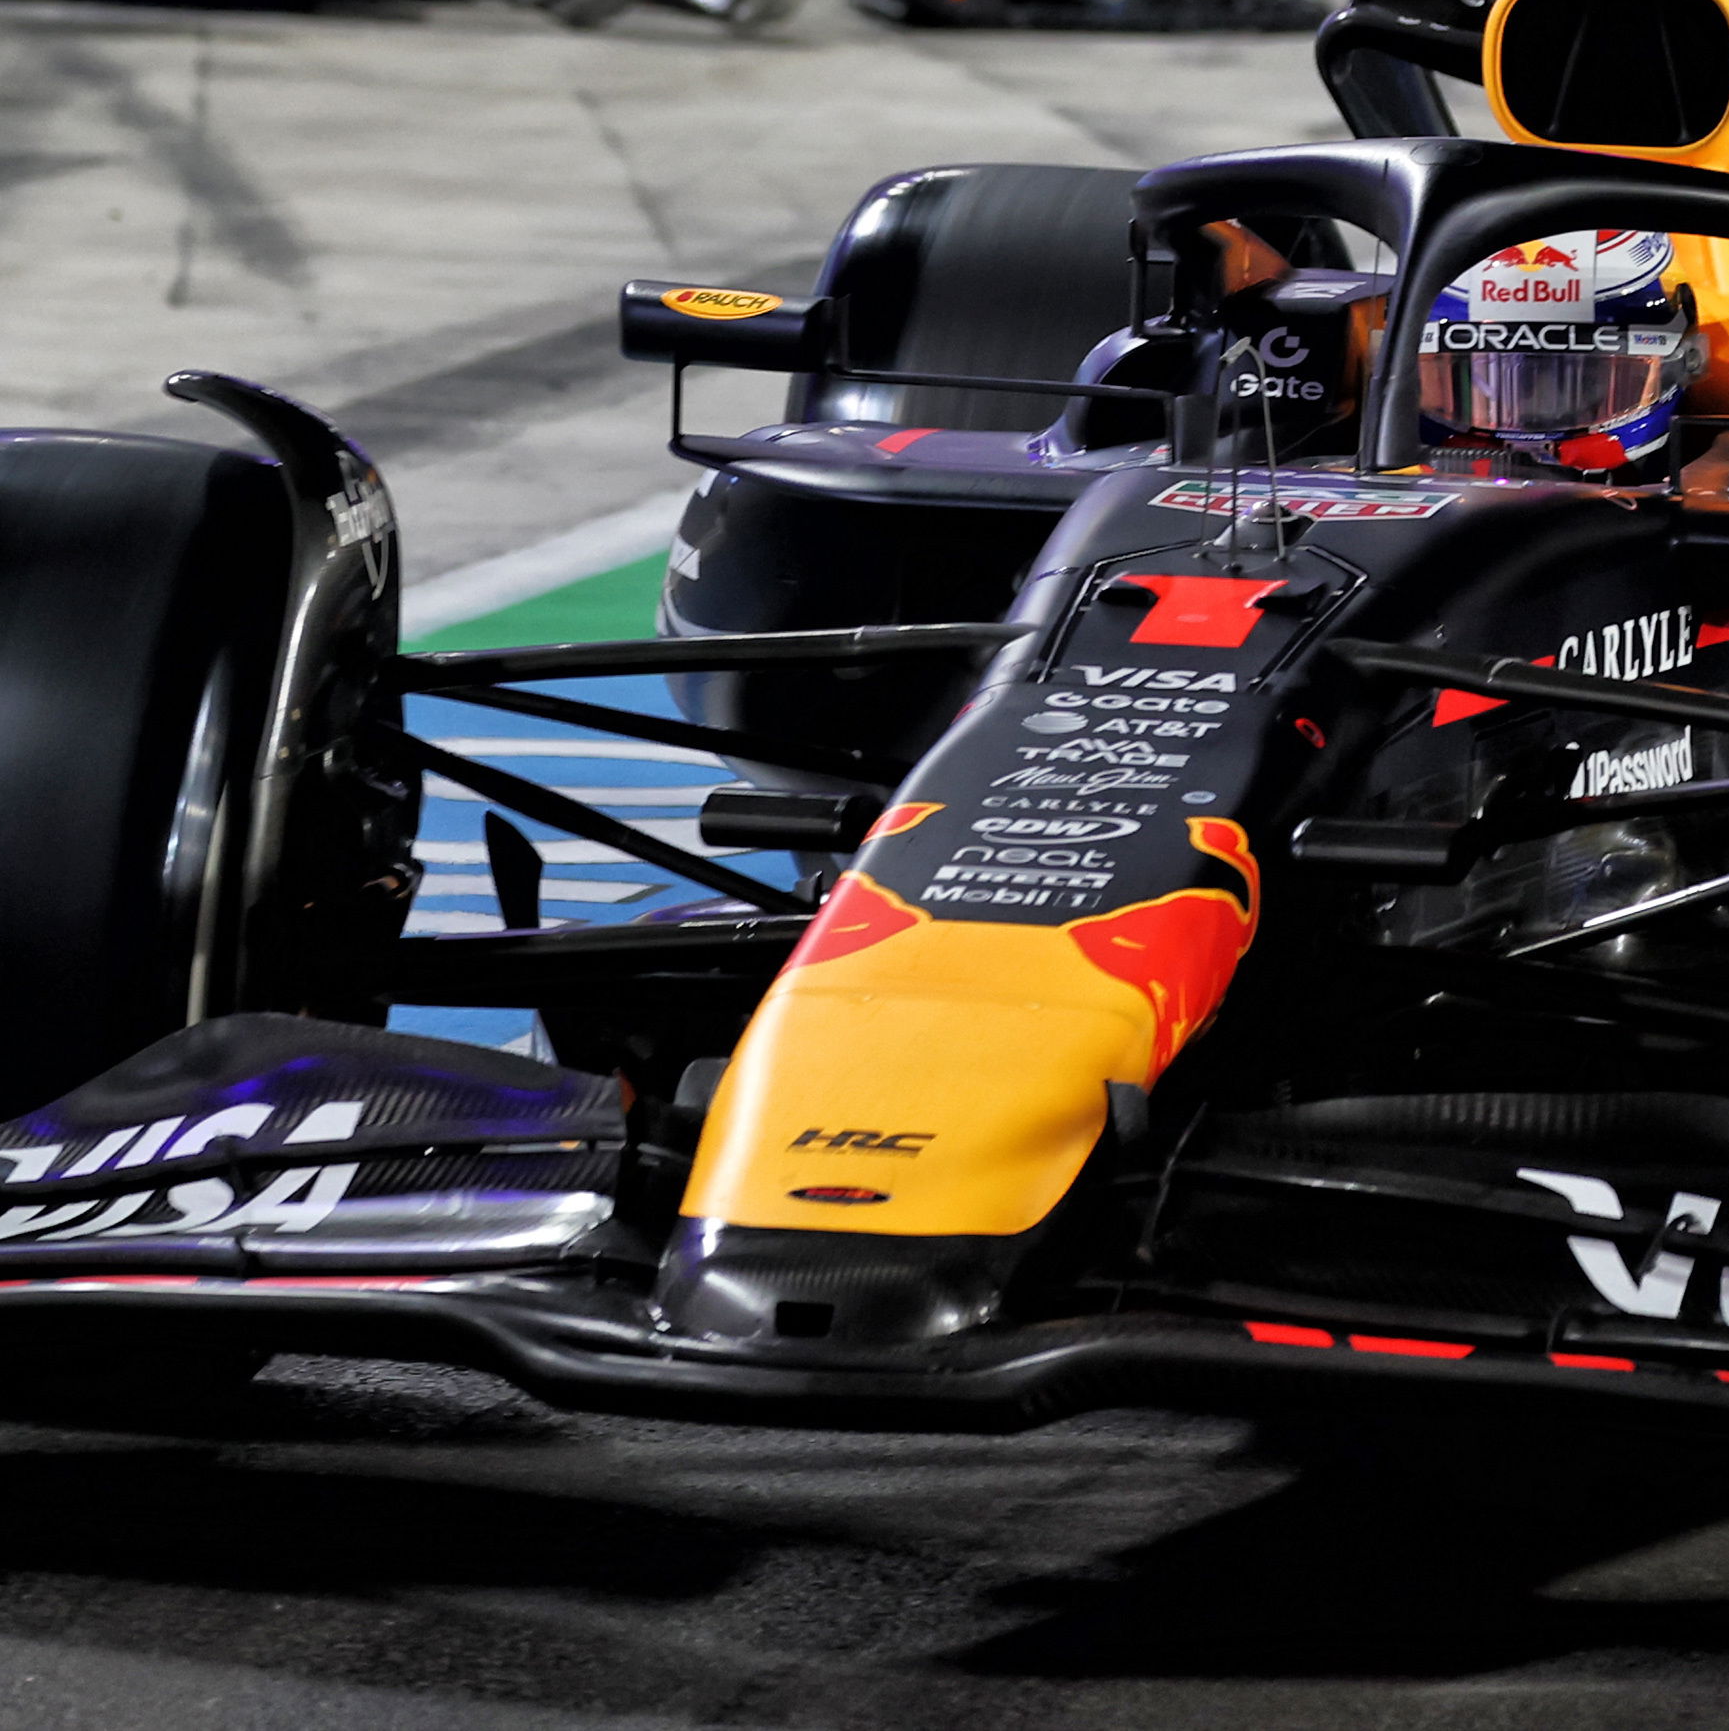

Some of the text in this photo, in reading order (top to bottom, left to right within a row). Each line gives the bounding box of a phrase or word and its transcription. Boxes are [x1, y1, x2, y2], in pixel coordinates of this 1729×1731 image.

[690, 291, 770, 310] RAUCH
[1481, 279, 1581, 303] Red Bull
[1444, 324, 1622, 351] ORACLE
[1229, 372, 1325, 401] Gate
[1110, 574, 1290, 649] 1
[1558, 605, 1694, 682] CARLYLE
[1071, 665, 1237, 693] VISA
[1091, 694, 1231, 715] Gate
[1092, 718, 1223, 738] AT&T
[1016, 746, 1191, 768] TRADE
[1586, 724, 1693, 797] 1Password
[989, 766, 1086, 789] Maui
[980, 796, 1159, 816] CARLYLE
[972, 817, 1102, 837] CDW
[933, 865, 1114, 889] PIRELLI
[920, 884, 1052, 907] Mobil
[786, 1127, 937, 1153] HRC
